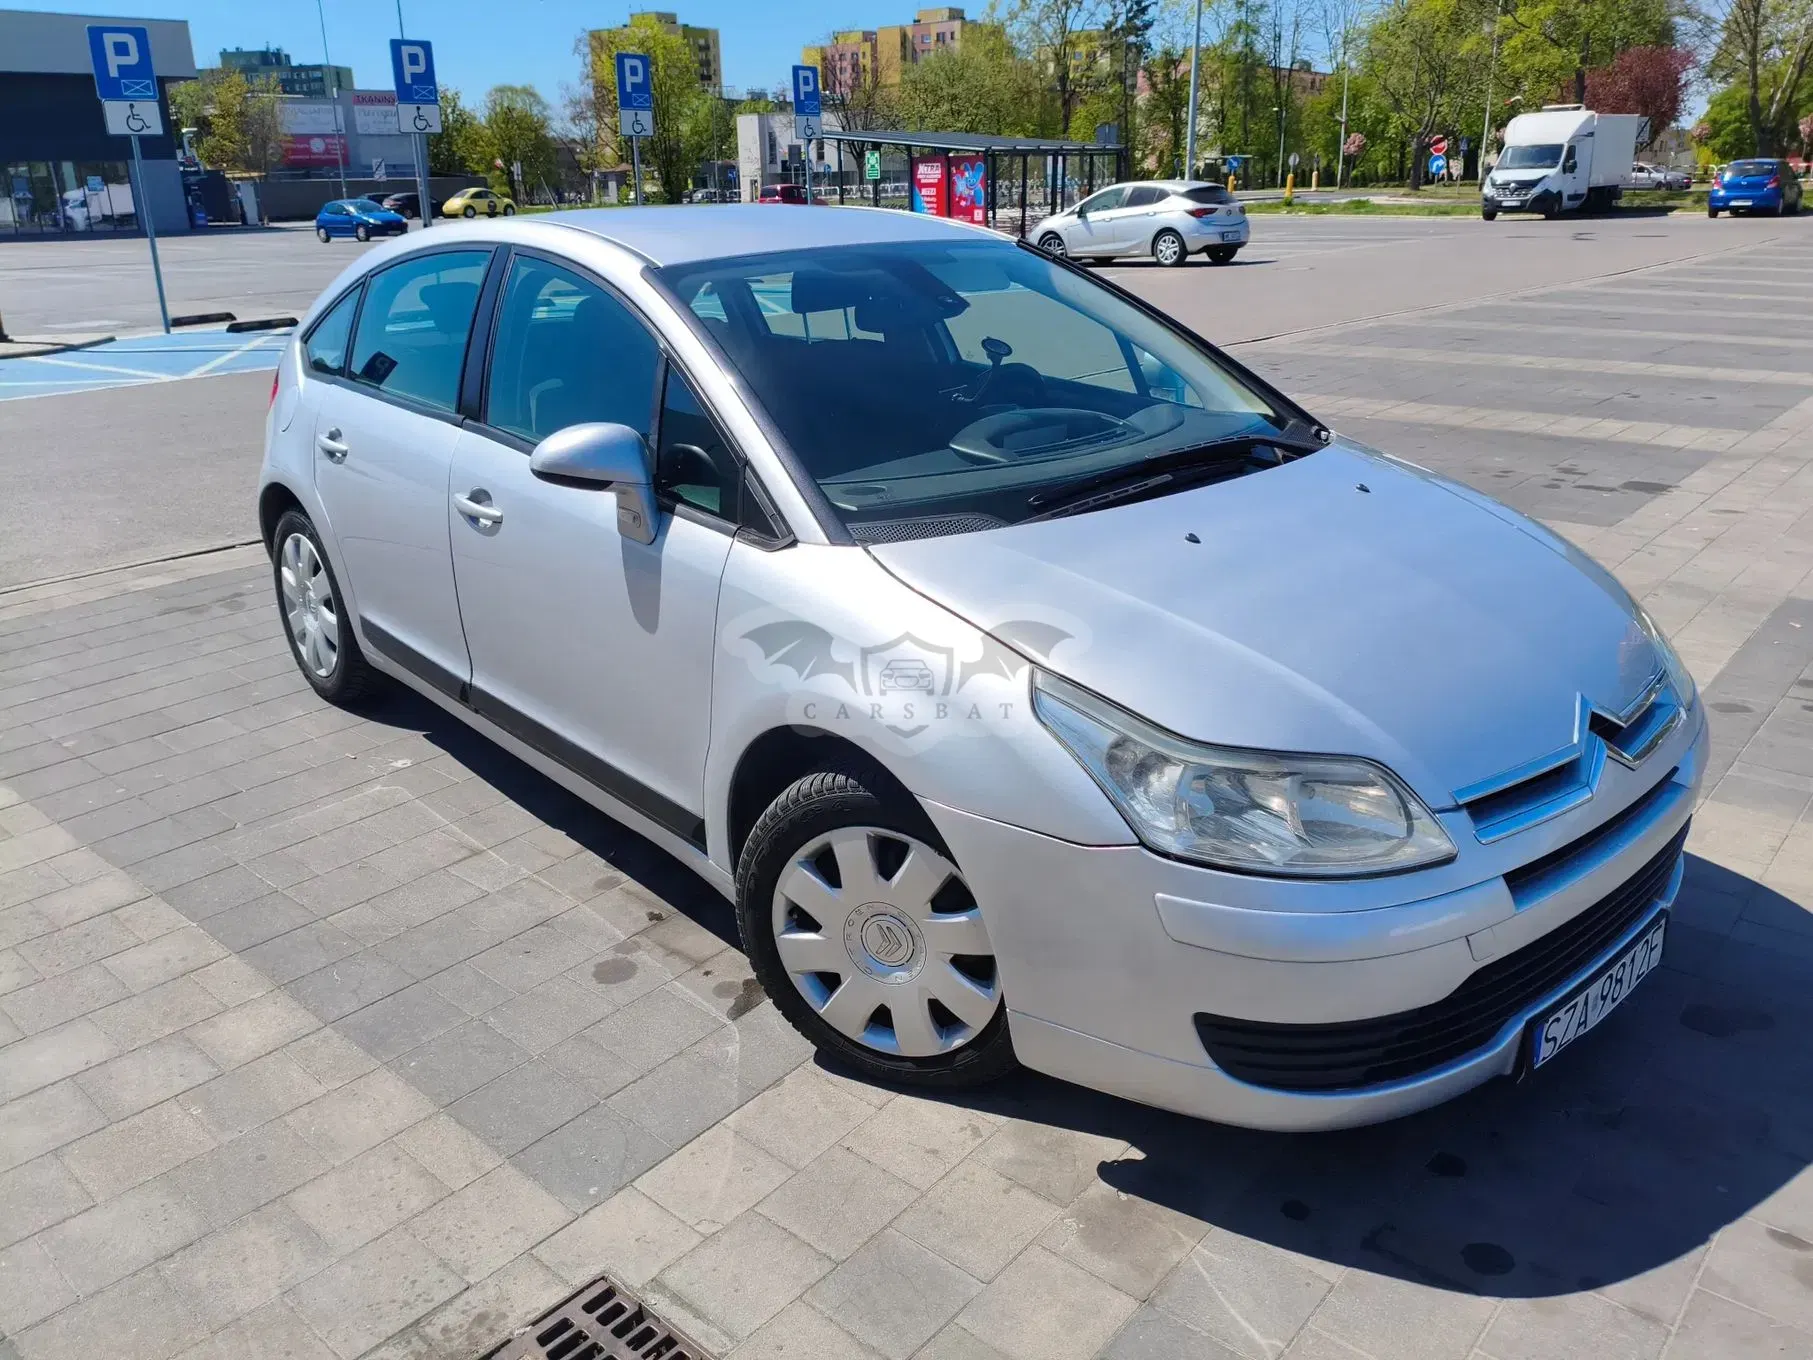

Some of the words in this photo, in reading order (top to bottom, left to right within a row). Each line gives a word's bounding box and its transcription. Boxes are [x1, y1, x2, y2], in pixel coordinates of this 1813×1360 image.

[103, 33, 139, 77] P
[401, 46, 425, 84] P
[624, 58, 643, 92] P
[799, 70, 813, 100] P
[1542, 991, 1590, 1059] SZA
[1597, 924, 1662, 1017] 9812F
